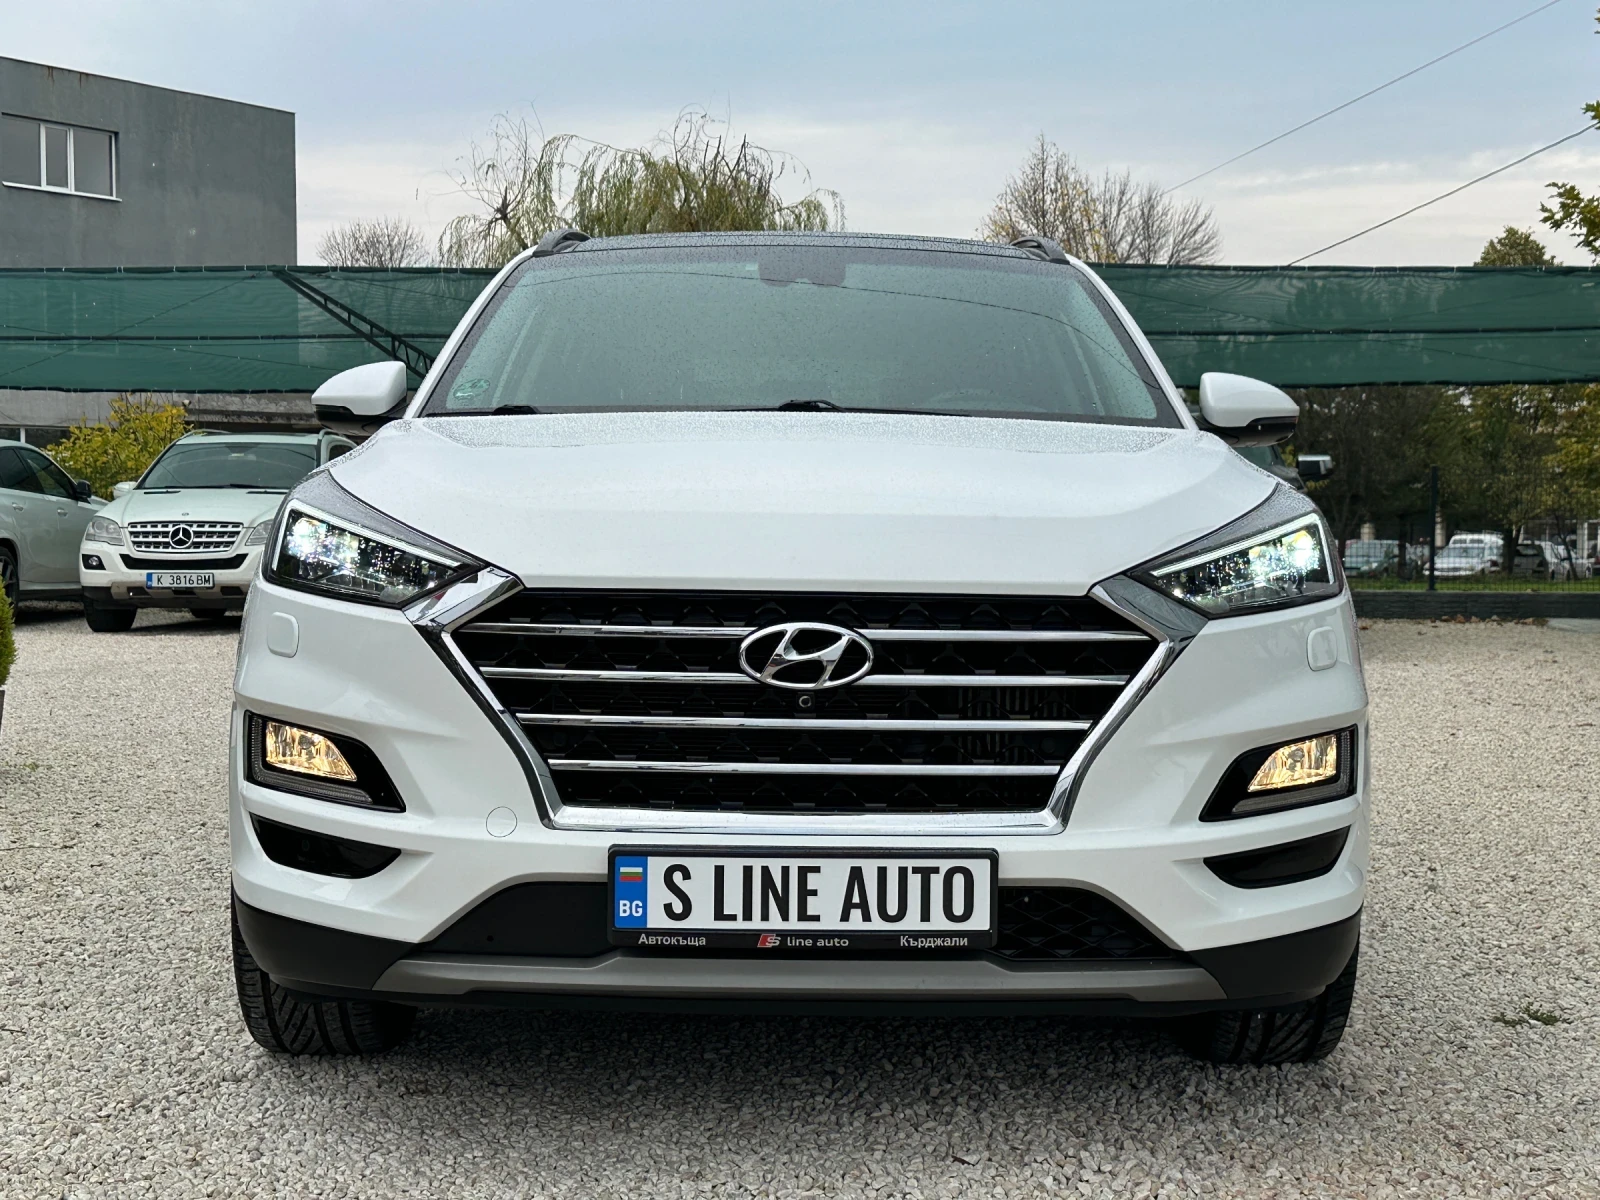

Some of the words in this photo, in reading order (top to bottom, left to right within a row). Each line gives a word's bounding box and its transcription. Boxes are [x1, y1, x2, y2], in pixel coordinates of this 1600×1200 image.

[663, 863, 693, 922] S
[713, 864, 821, 923] LINE
[839, 864, 975, 923] AUTO
[619, 900, 643, 917] BG
[637, 933, 706, 948] Автокъща
[787, 936, 813, 947] line
[816, 937, 849, 947] auto
[899, 934, 968, 949] Кърджали
